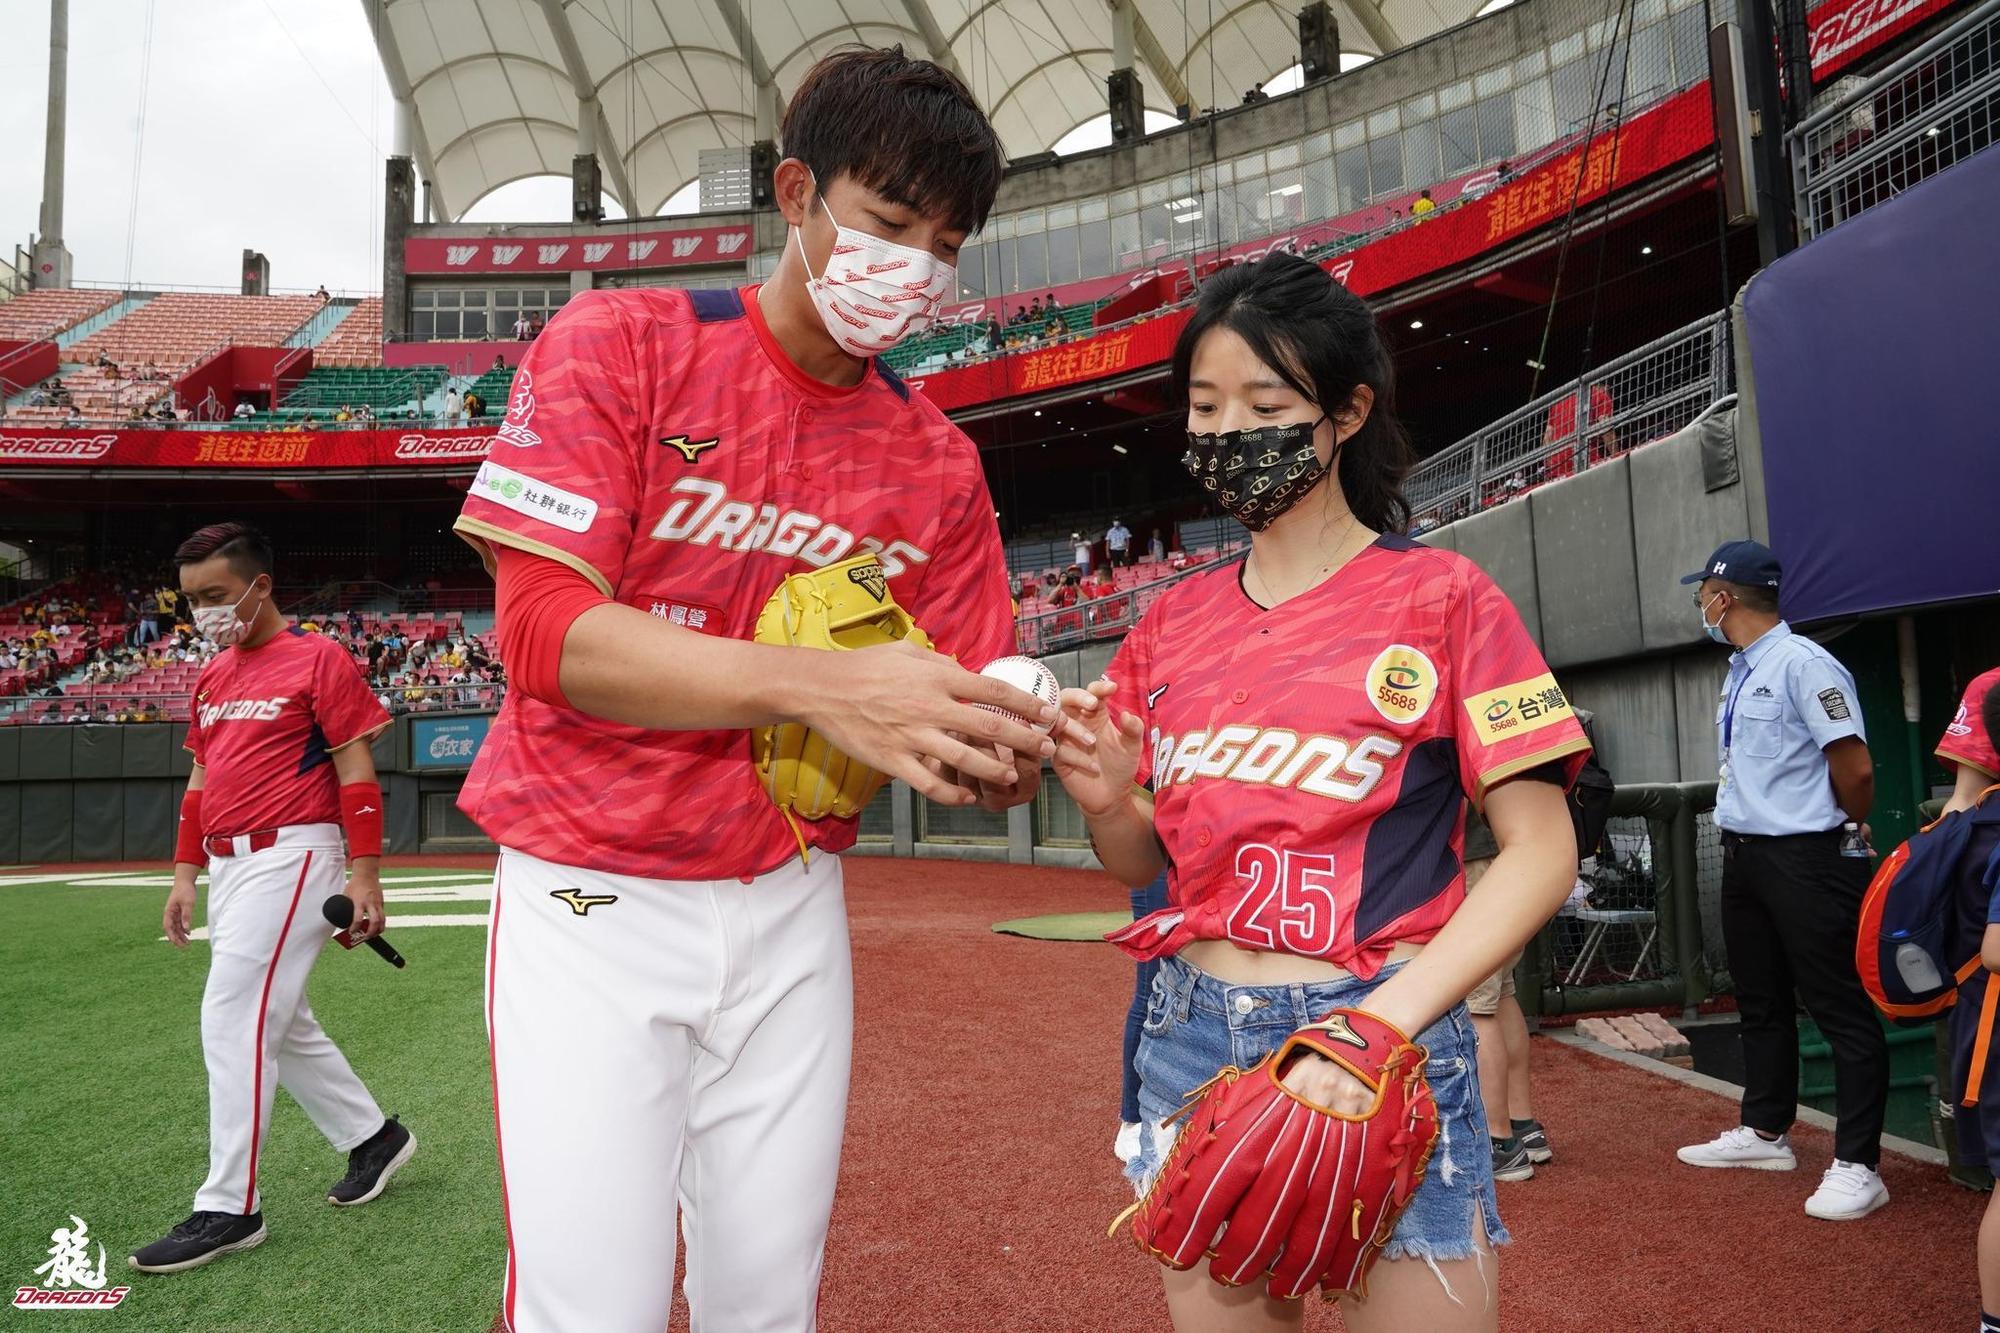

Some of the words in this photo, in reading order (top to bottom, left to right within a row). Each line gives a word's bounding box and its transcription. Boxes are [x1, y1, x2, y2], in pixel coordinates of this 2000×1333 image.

[0, 435, 118, 458] RAGONS
[1277, 429, 1300, 439] 55688
[523, 488, 587, 521] 社群銀行
[650, 602, 708, 629] 林鳳營
[1377, 686, 1418, 712] 55688
[1490, 717, 1518, 733] 55688
[1227, 843, 1336, 955] 25
